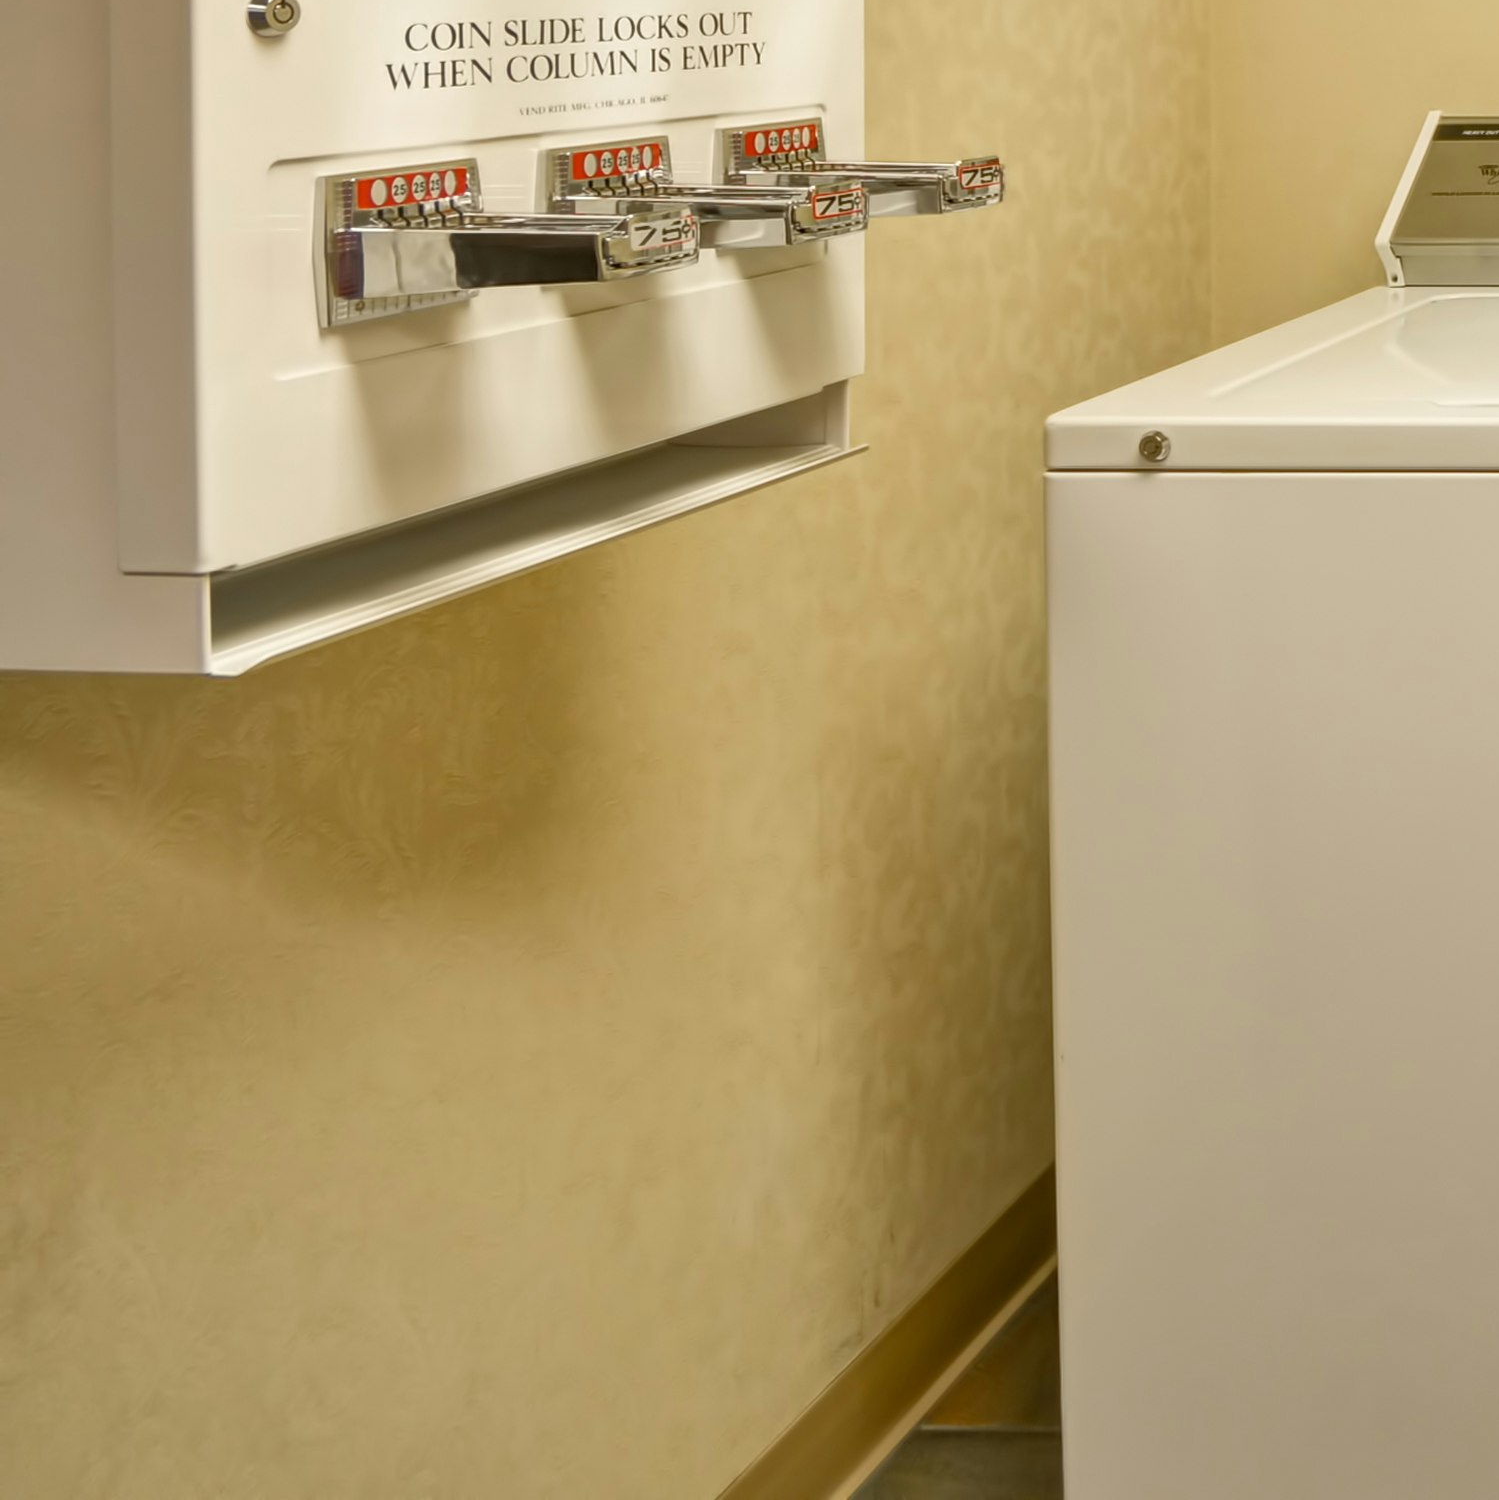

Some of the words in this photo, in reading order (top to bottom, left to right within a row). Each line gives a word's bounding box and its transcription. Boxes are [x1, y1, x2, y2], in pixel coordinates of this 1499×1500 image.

[404, 20, 493, 51] COIN
[504, 17, 586, 47] SLIDE
[598, 13, 690, 43] LOCKS
[699, 11, 753, 37] OUT
[385, 57, 494, 91] WHEN
[506, 49, 638, 83] COLUMN
[650, 47, 672, 73] IS
[682, 41, 767, 71] EMPTY
[520, 104, 546, 116] VEND
[602, 157, 613, 169] 25
[618, 155, 628, 167] 25
[962, 165, 1000, 186] 75¢
[393, 185, 407, 197] 25
[413, 182, 426, 194] 25
[430, 181, 441, 192] 25
[815, 191, 861, 216] 75¢
[634, 219, 692, 247] 75¢
